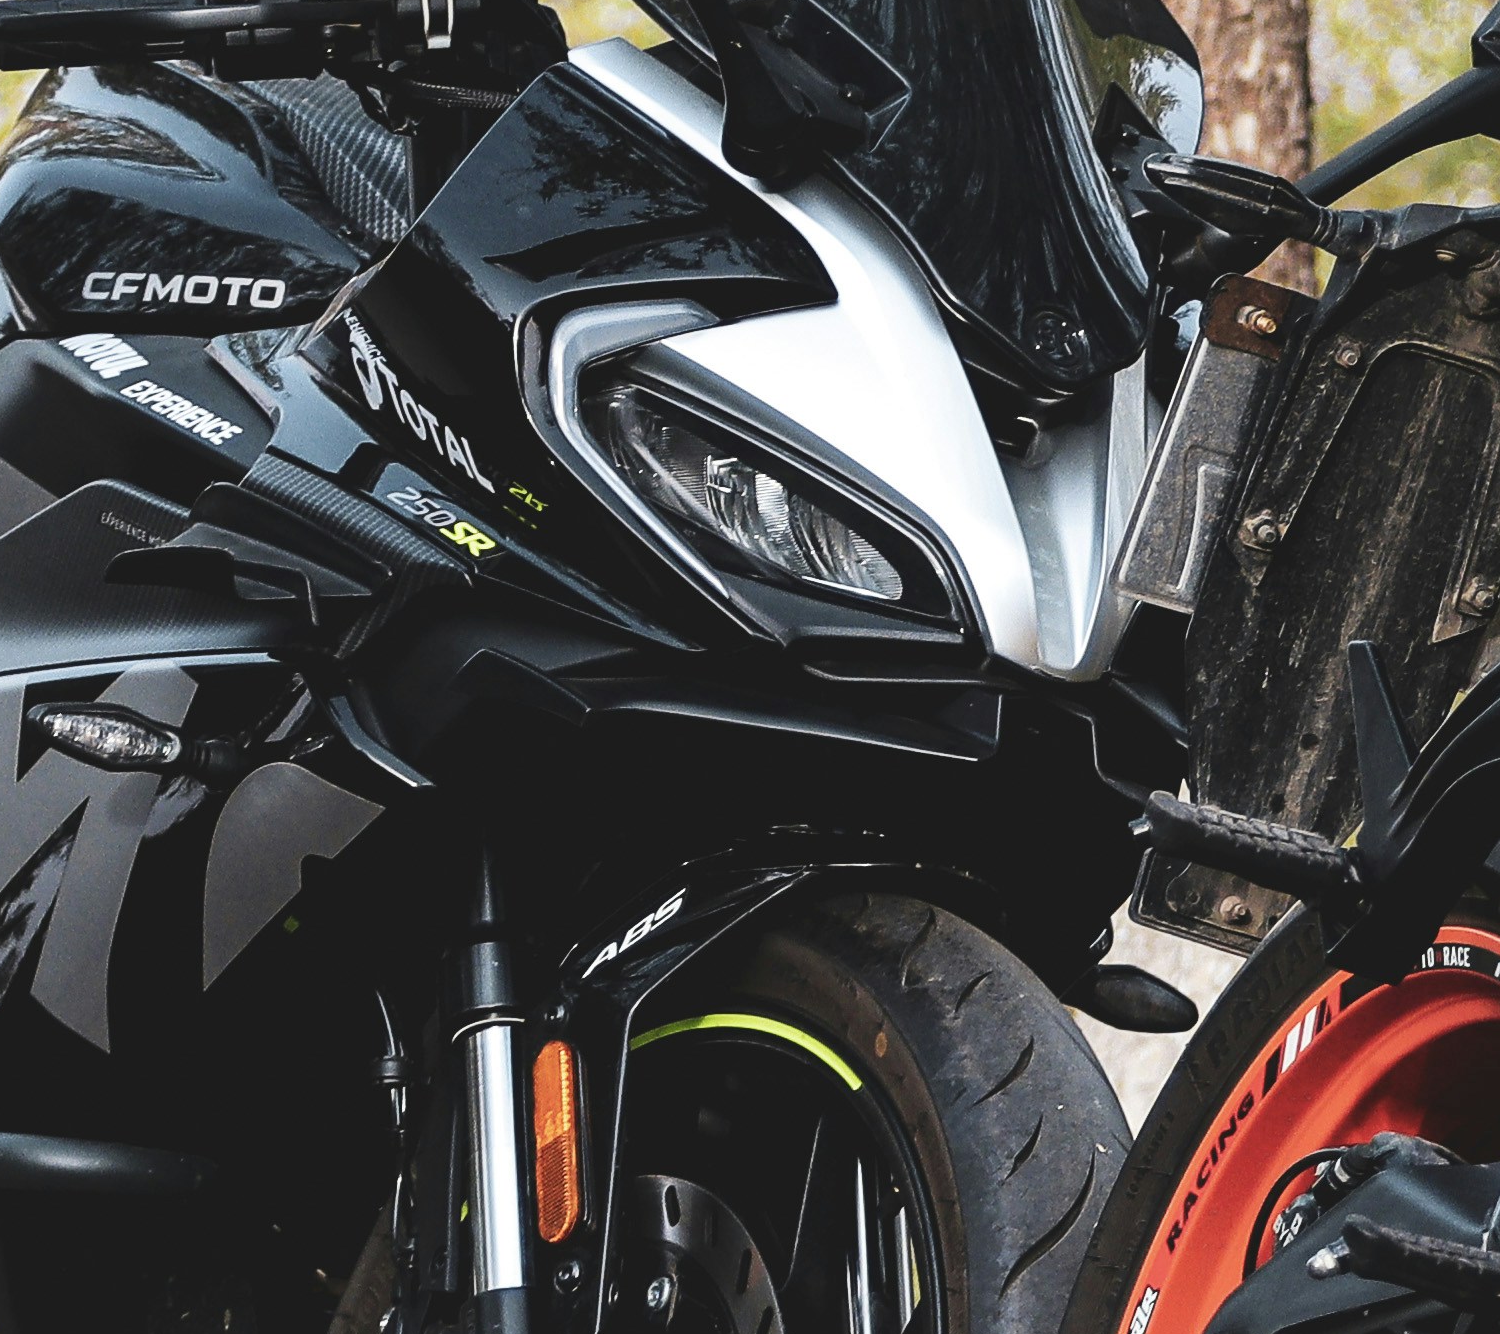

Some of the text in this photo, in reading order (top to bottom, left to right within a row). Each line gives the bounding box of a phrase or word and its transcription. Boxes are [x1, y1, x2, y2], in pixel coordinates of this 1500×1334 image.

[82, 271, 286, 309] CFMOTO
[120, 380, 243, 446] EXPERIENCE
[376, 359, 496, 494] TOTAL
[387, 486, 496, 557] 250SR
[581, 887, 688, 979] ABS
[1442, 946, 1471, 968] RACE
[1165, 1089, 1255, 1255] RACING
